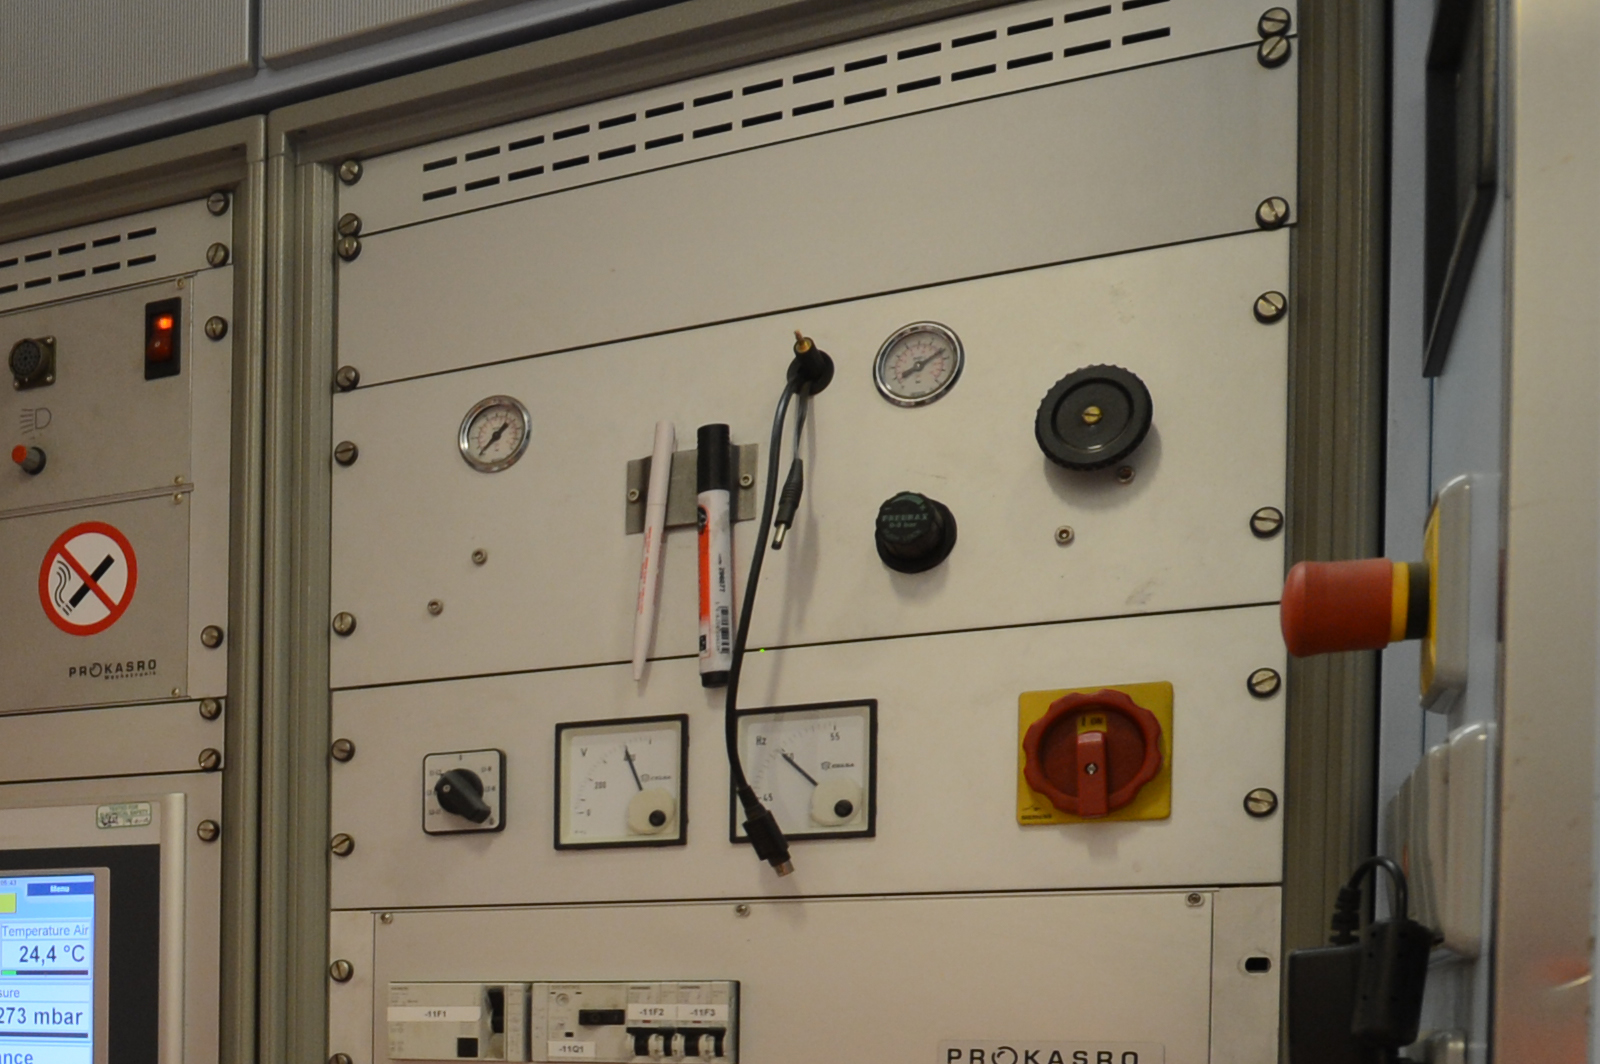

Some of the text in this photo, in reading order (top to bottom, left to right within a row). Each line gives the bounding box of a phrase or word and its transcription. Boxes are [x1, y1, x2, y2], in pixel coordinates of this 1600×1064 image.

[68, 658, 157, 678] PROKASRO
[755, 736, 767, 746] Hz
[830, 732, 841, 742] 55
[580, 748, 589, 757] V
[50, 885, 70, 893] Menu
[2, 924, 89, 938] Temperature Air
[18, 944, 85, 965] 24,4 °C
[33, 1007, 83, 1025] mbar
[639, 1008, 664, 1017] -11F2
[689, 1008, 716, 1017] -11F3
[559, 1044, 584, 1053] -11Q1
